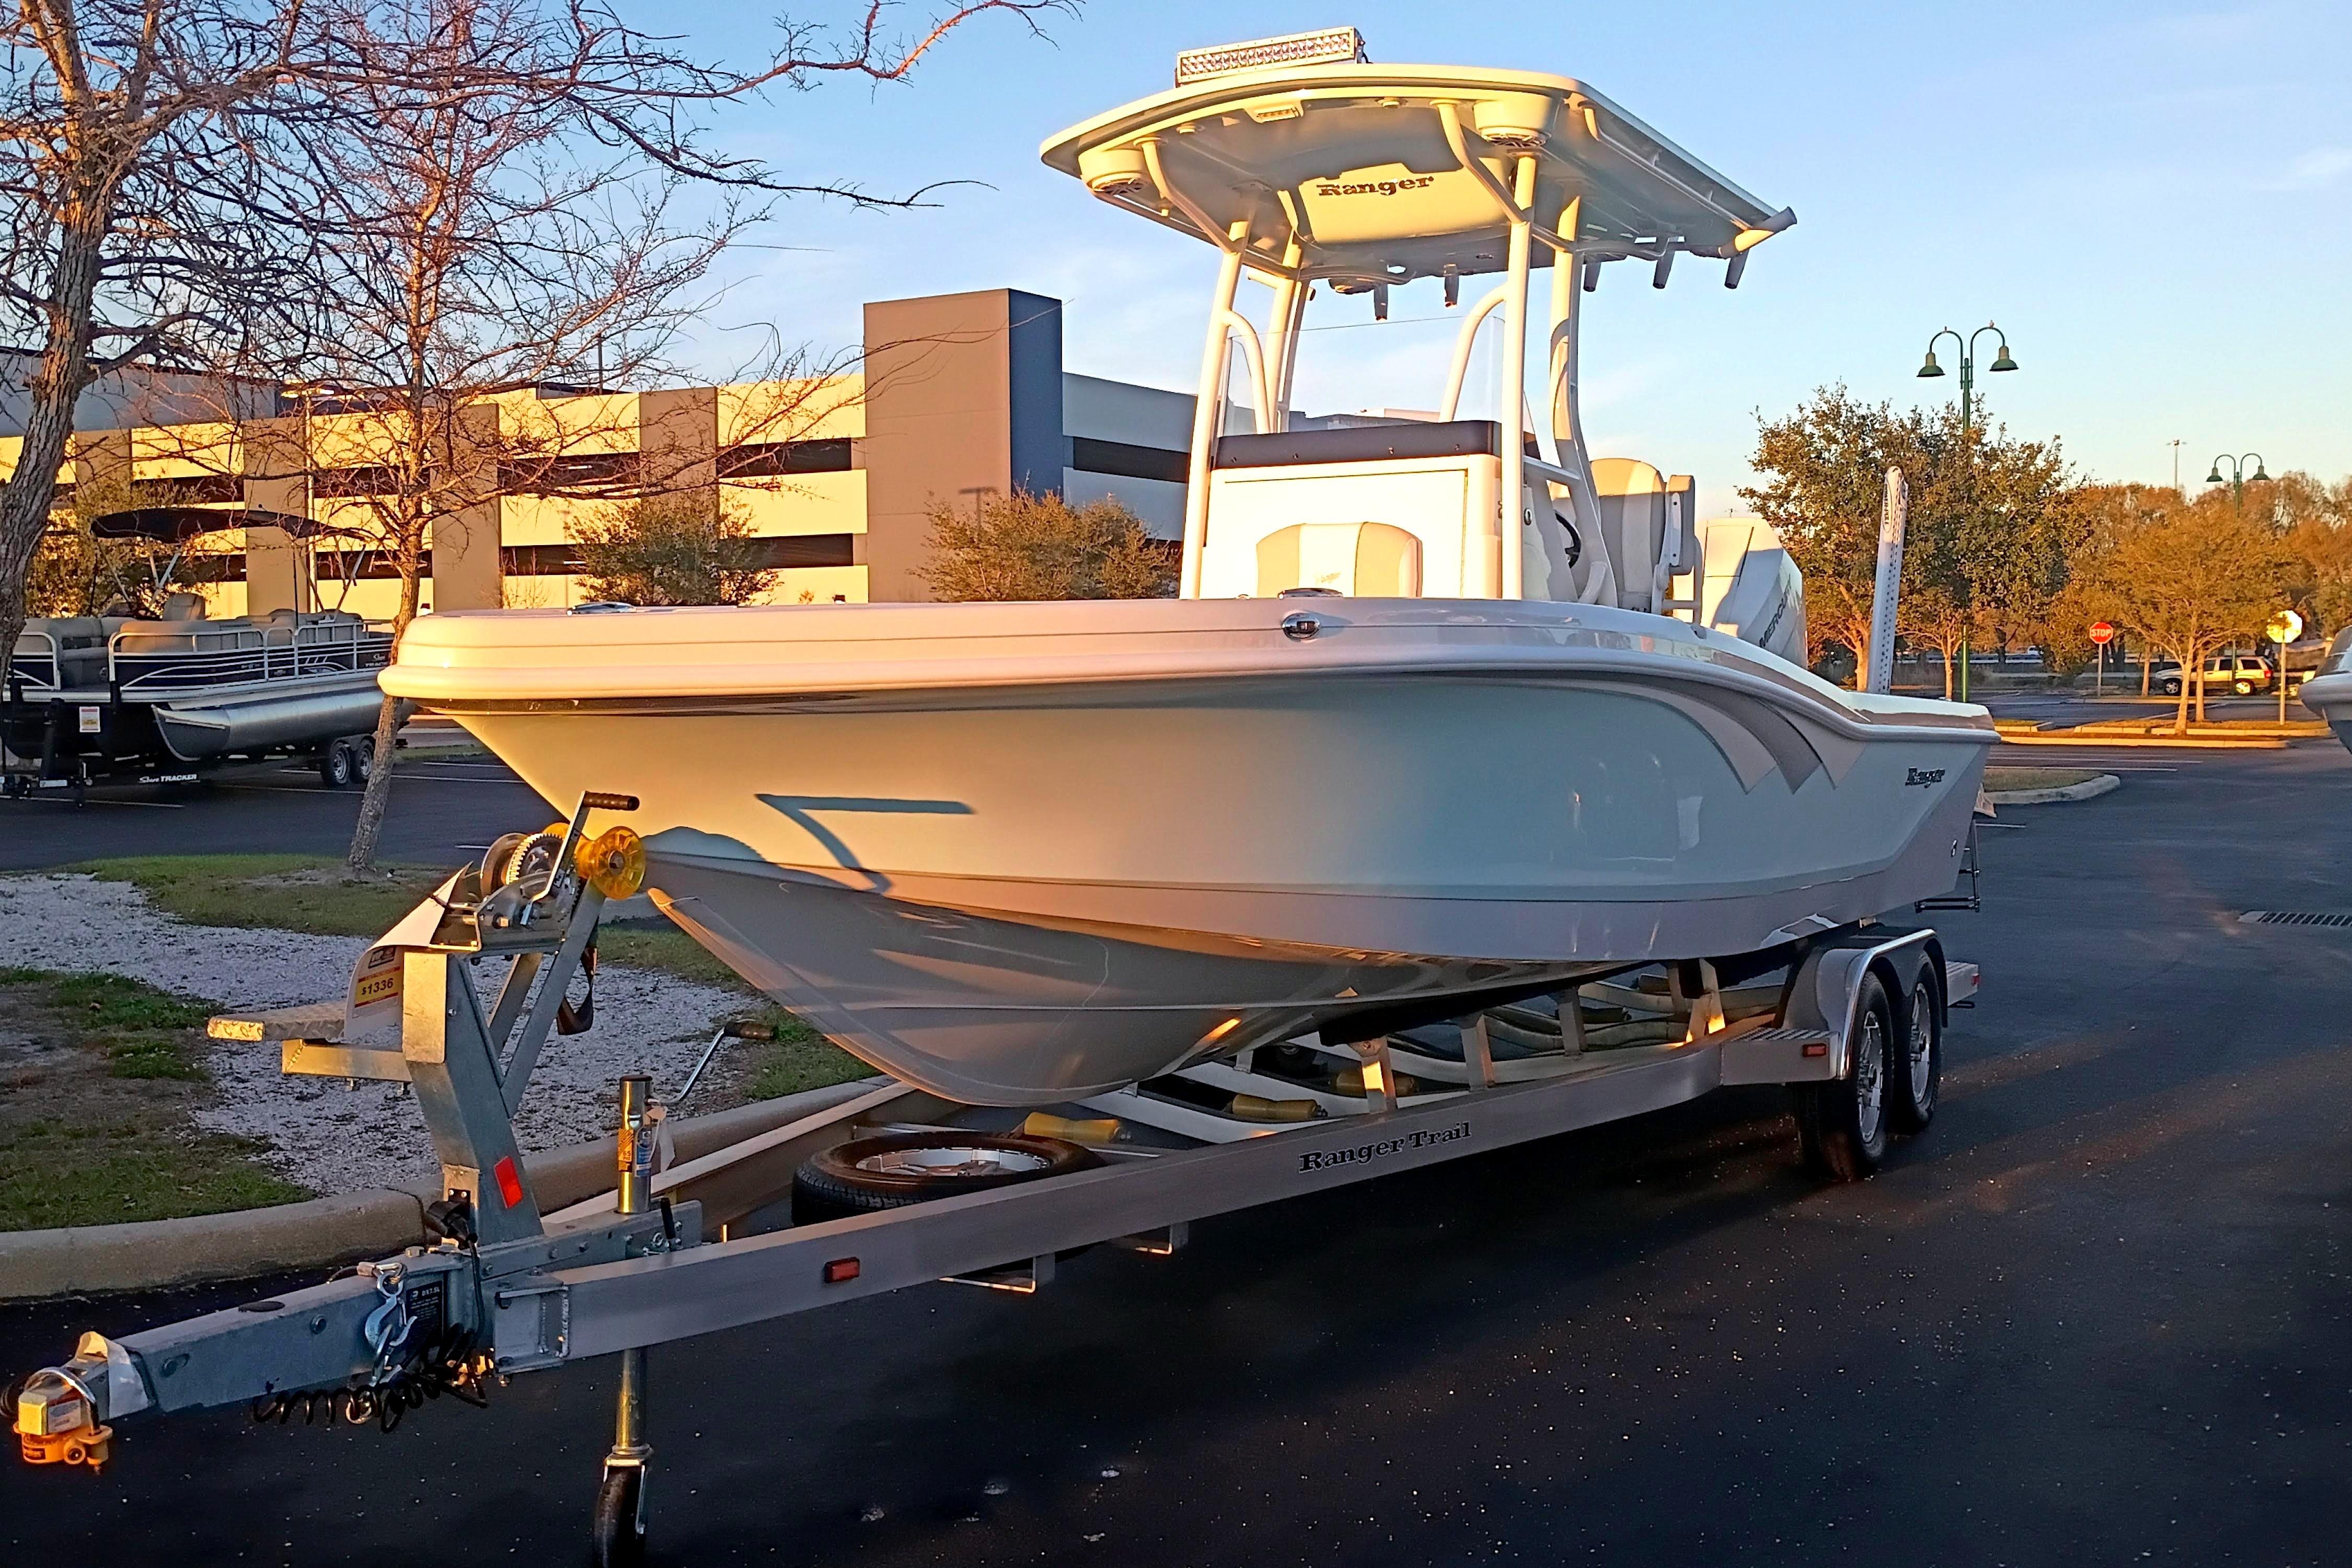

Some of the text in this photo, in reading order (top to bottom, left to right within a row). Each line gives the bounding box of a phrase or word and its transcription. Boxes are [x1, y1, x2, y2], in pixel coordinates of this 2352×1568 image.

[1316, 176, 1434, 196] Ranger
[2091, 628, 2111, 637] STOP
[1299, 1121, 1471, 1173] Ranger Trail
